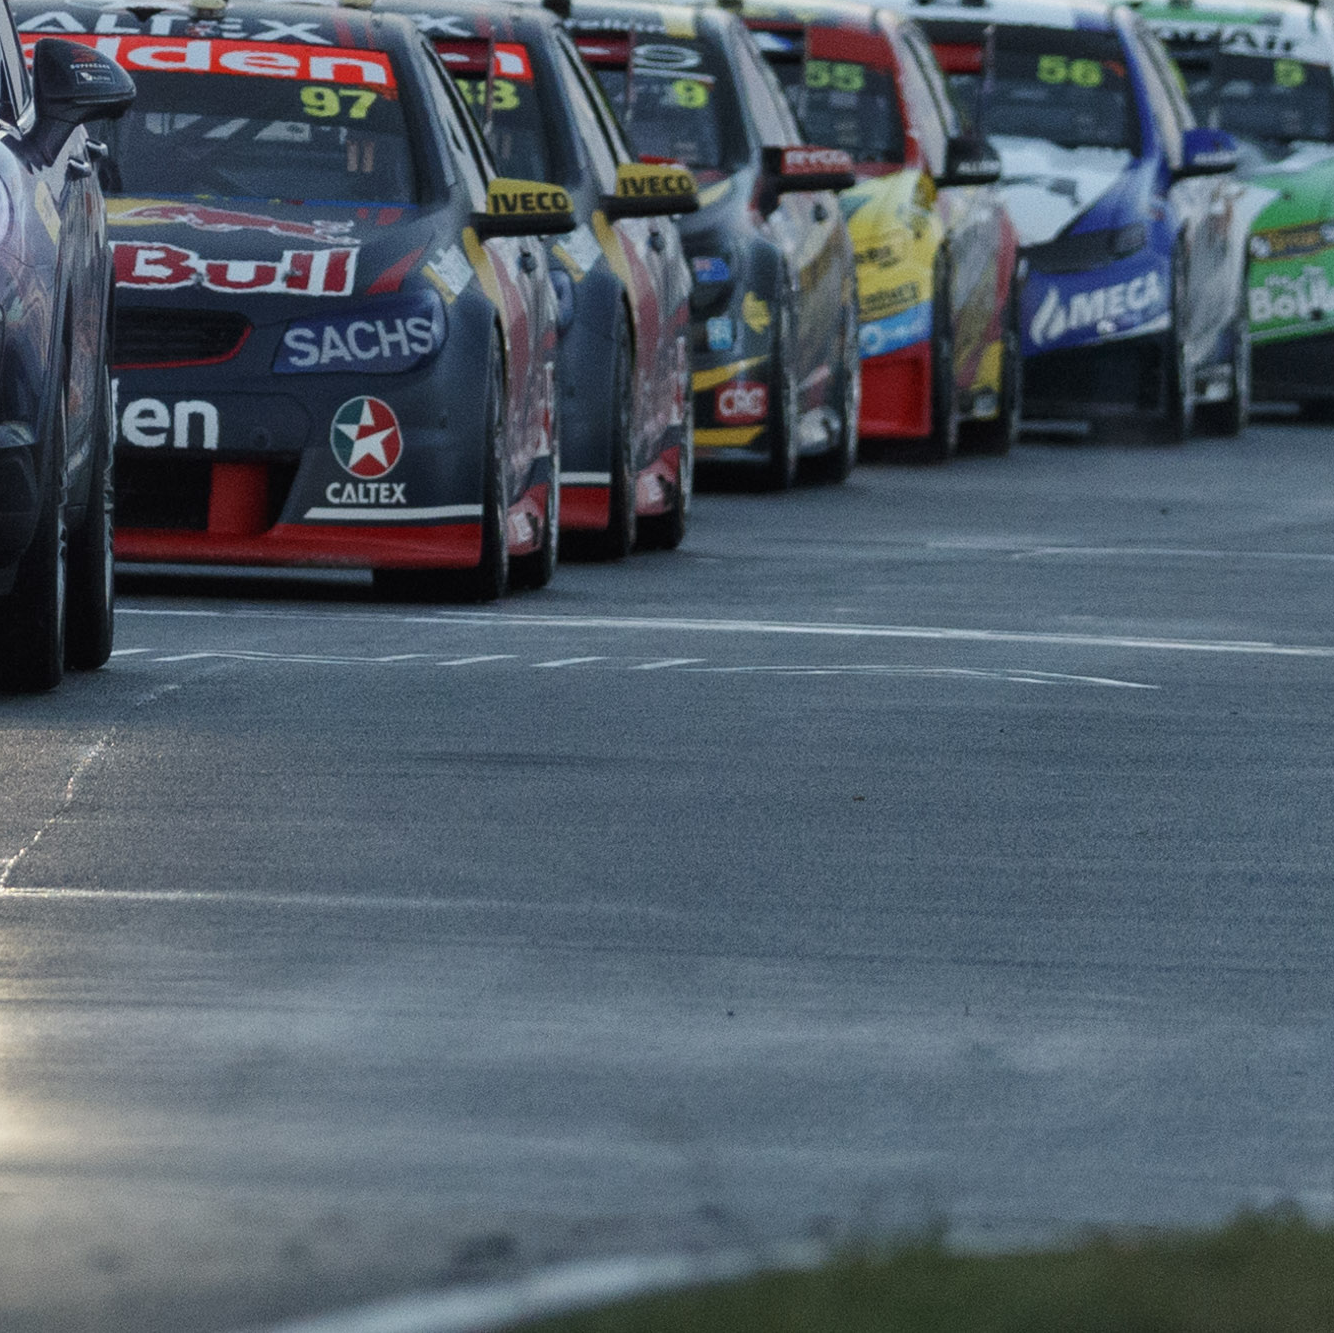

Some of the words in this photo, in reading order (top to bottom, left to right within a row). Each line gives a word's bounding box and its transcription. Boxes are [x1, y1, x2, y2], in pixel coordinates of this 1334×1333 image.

[299, 85, 377, 119] 97
[620, 174, 694, 196] IVECO
[490, 191, 569, 214] IVECO
[108, 240, 361, 297] Bull
[282, 317, 434, 366] SACHS
[325, 481, 407, 504] CALTEX
